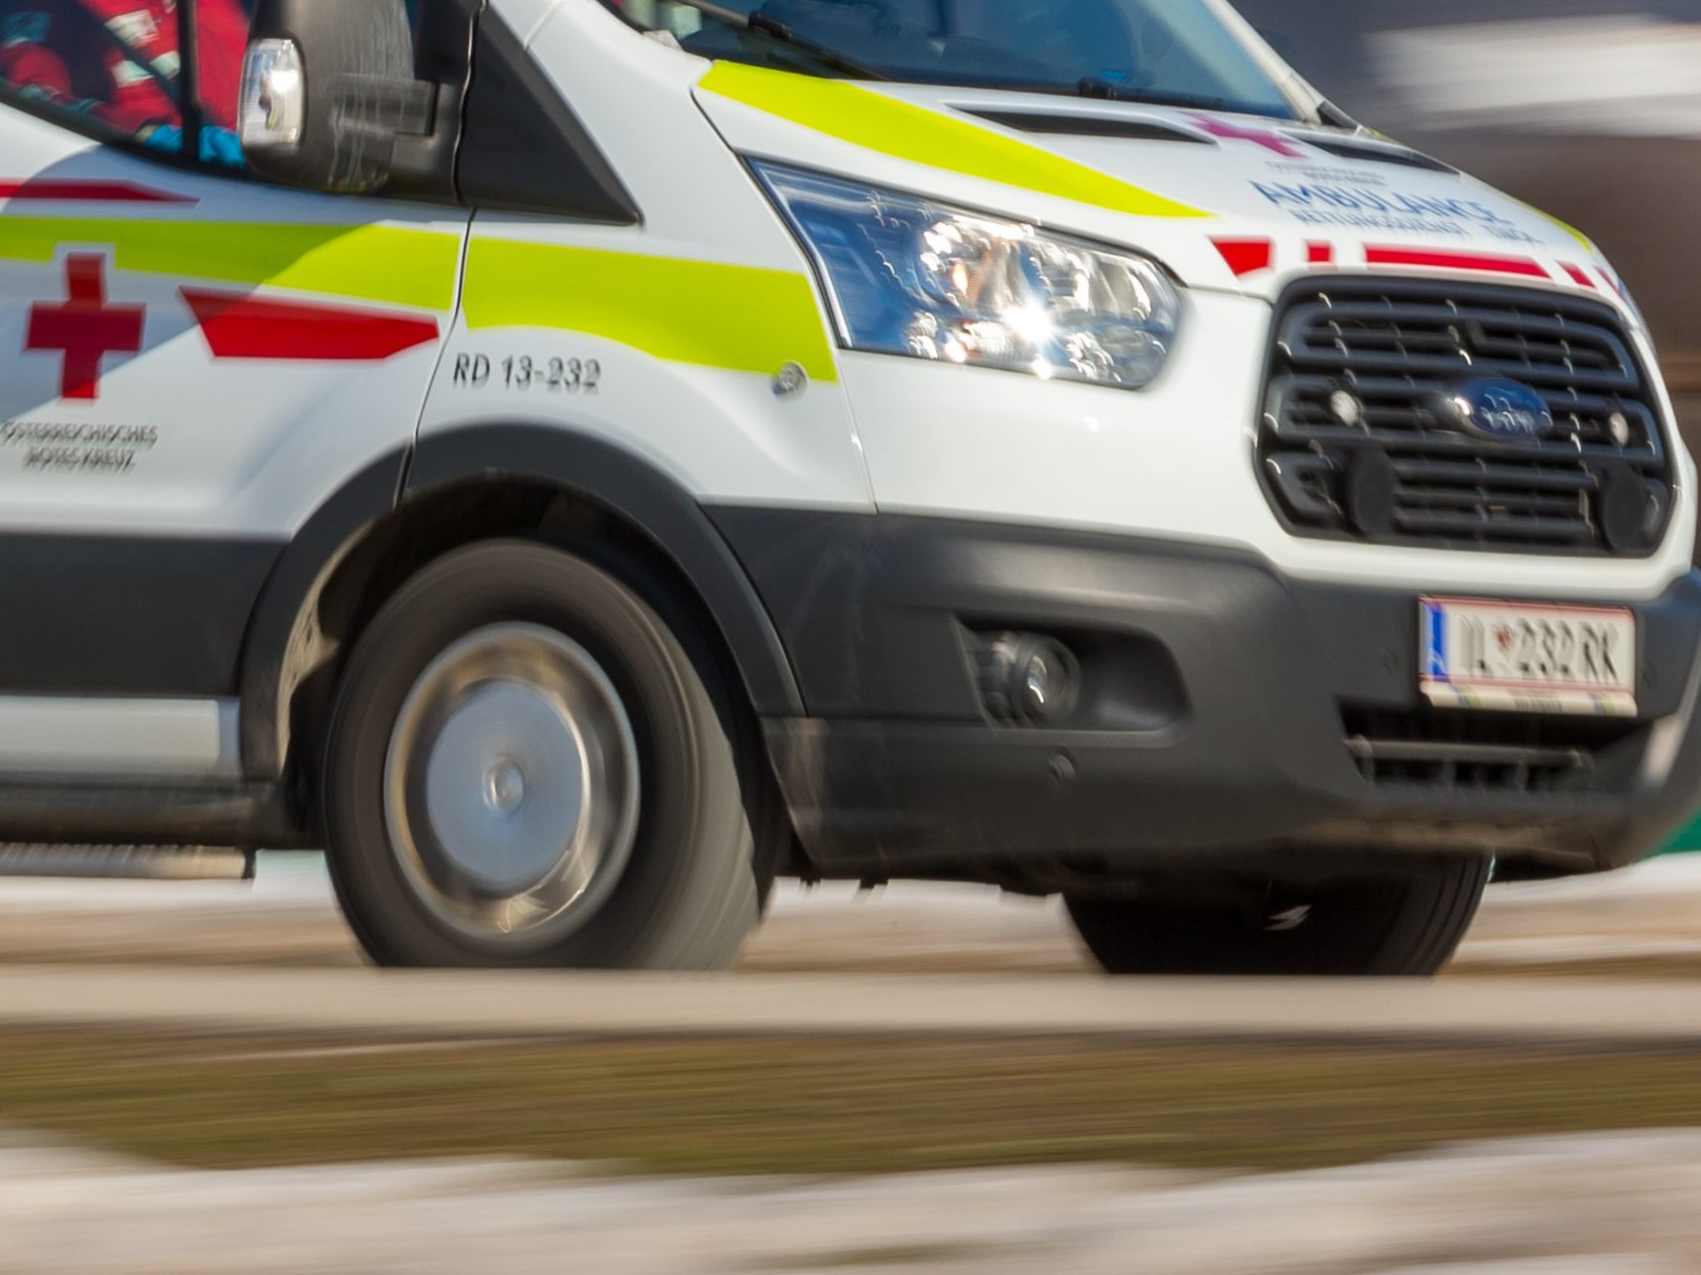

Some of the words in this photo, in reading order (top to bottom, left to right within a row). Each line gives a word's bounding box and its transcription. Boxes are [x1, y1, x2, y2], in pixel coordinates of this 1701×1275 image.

[1248, 180, 1514, 226] AMBULANCE
[453, 352, 492, 388] RD
[501, 354, 602, 395] 13-232
